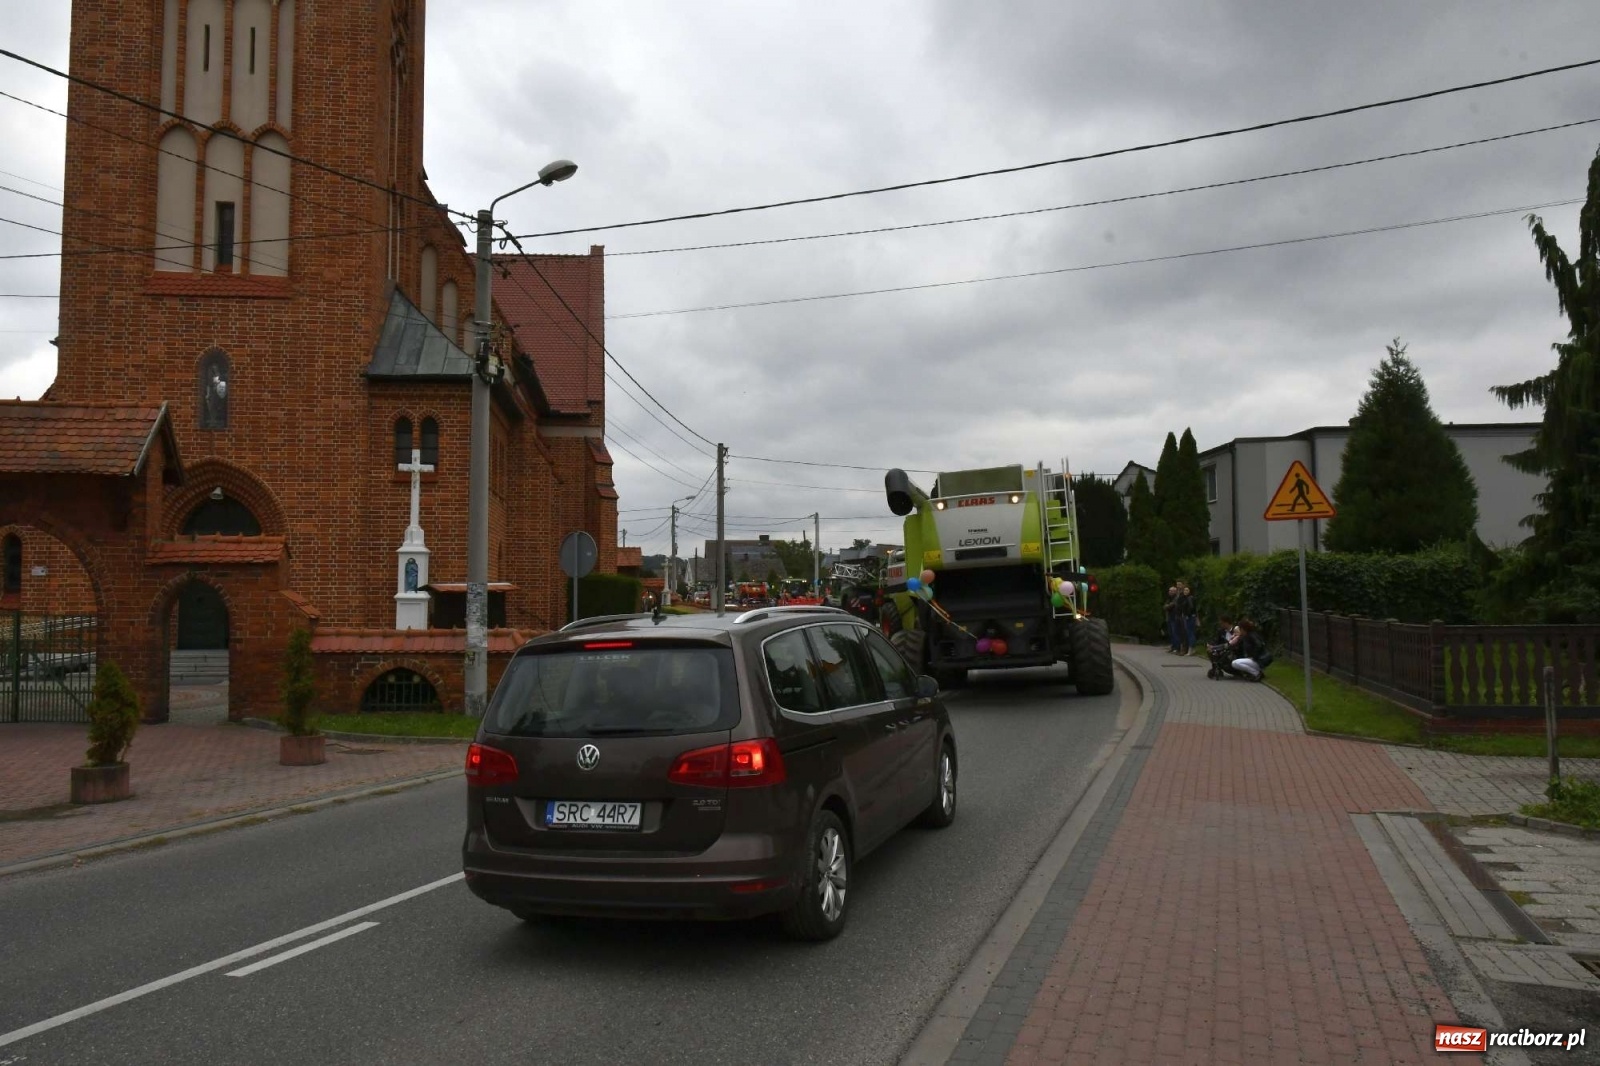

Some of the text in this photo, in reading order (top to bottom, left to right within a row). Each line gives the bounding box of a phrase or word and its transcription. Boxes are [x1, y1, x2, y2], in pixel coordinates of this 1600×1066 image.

[957, 496, 996, 508] CLAAS
[958, 536, 1001, 547] LEXION
[556, 803, 638, 823] SRC 44R7
